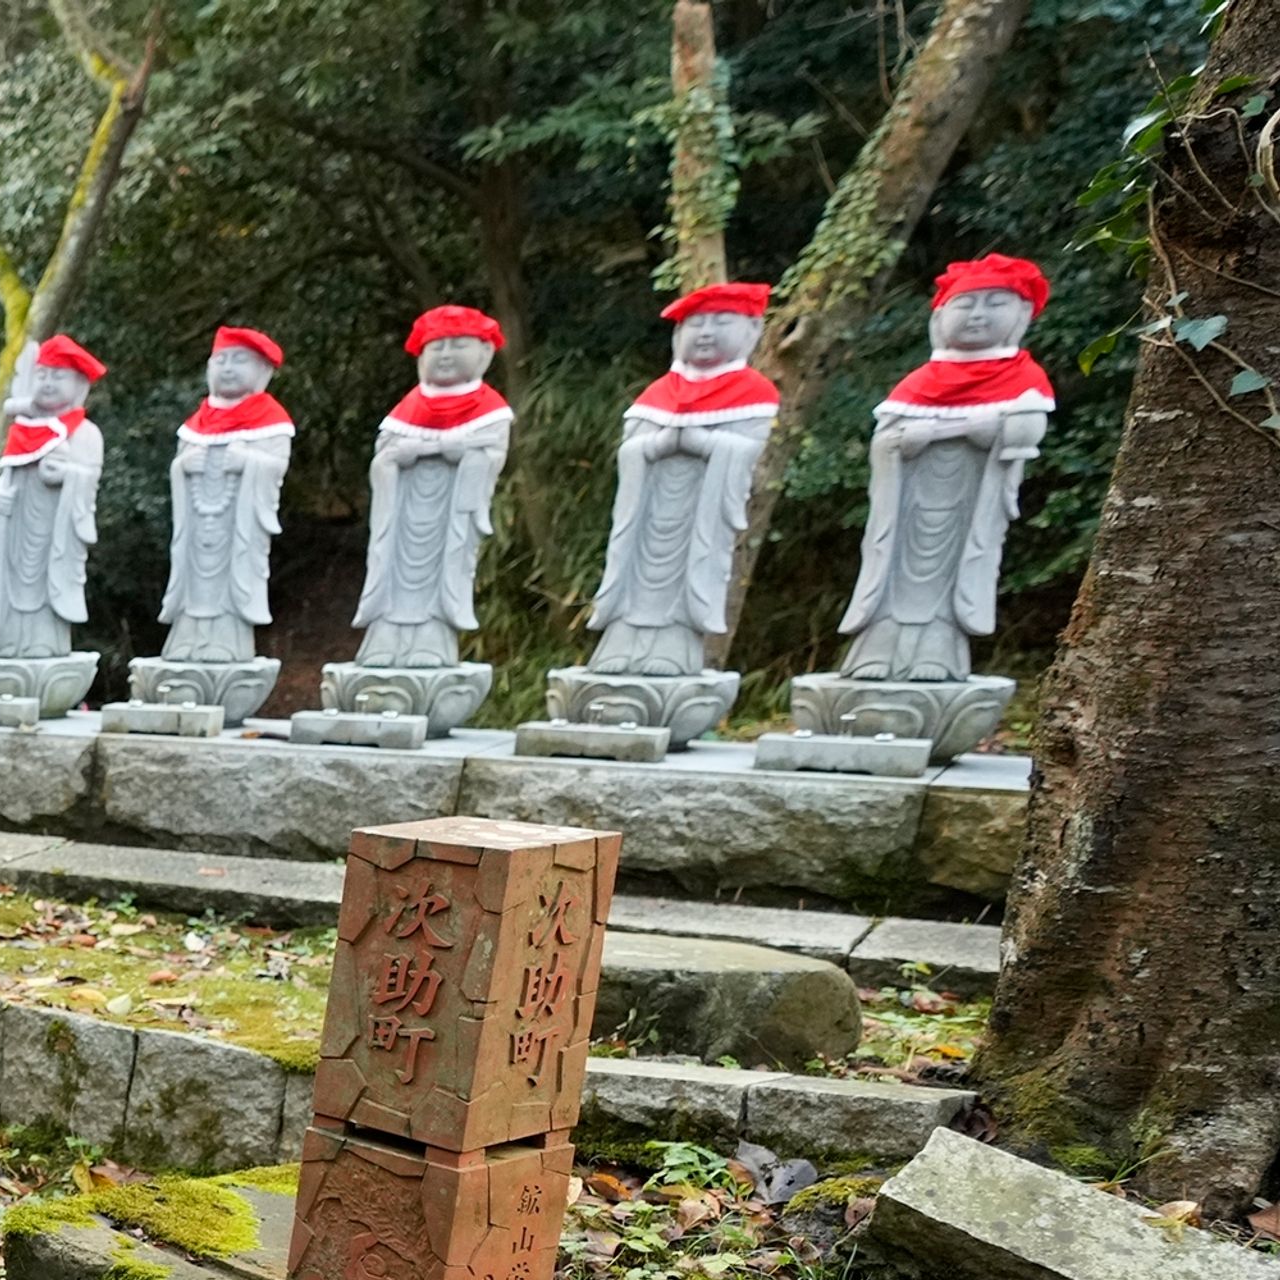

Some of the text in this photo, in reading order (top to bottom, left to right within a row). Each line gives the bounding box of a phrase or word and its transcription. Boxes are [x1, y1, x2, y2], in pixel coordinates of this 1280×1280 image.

[367, 877, 454, 1084] 次助町
[510, 880, 580, 1087] 次助町
